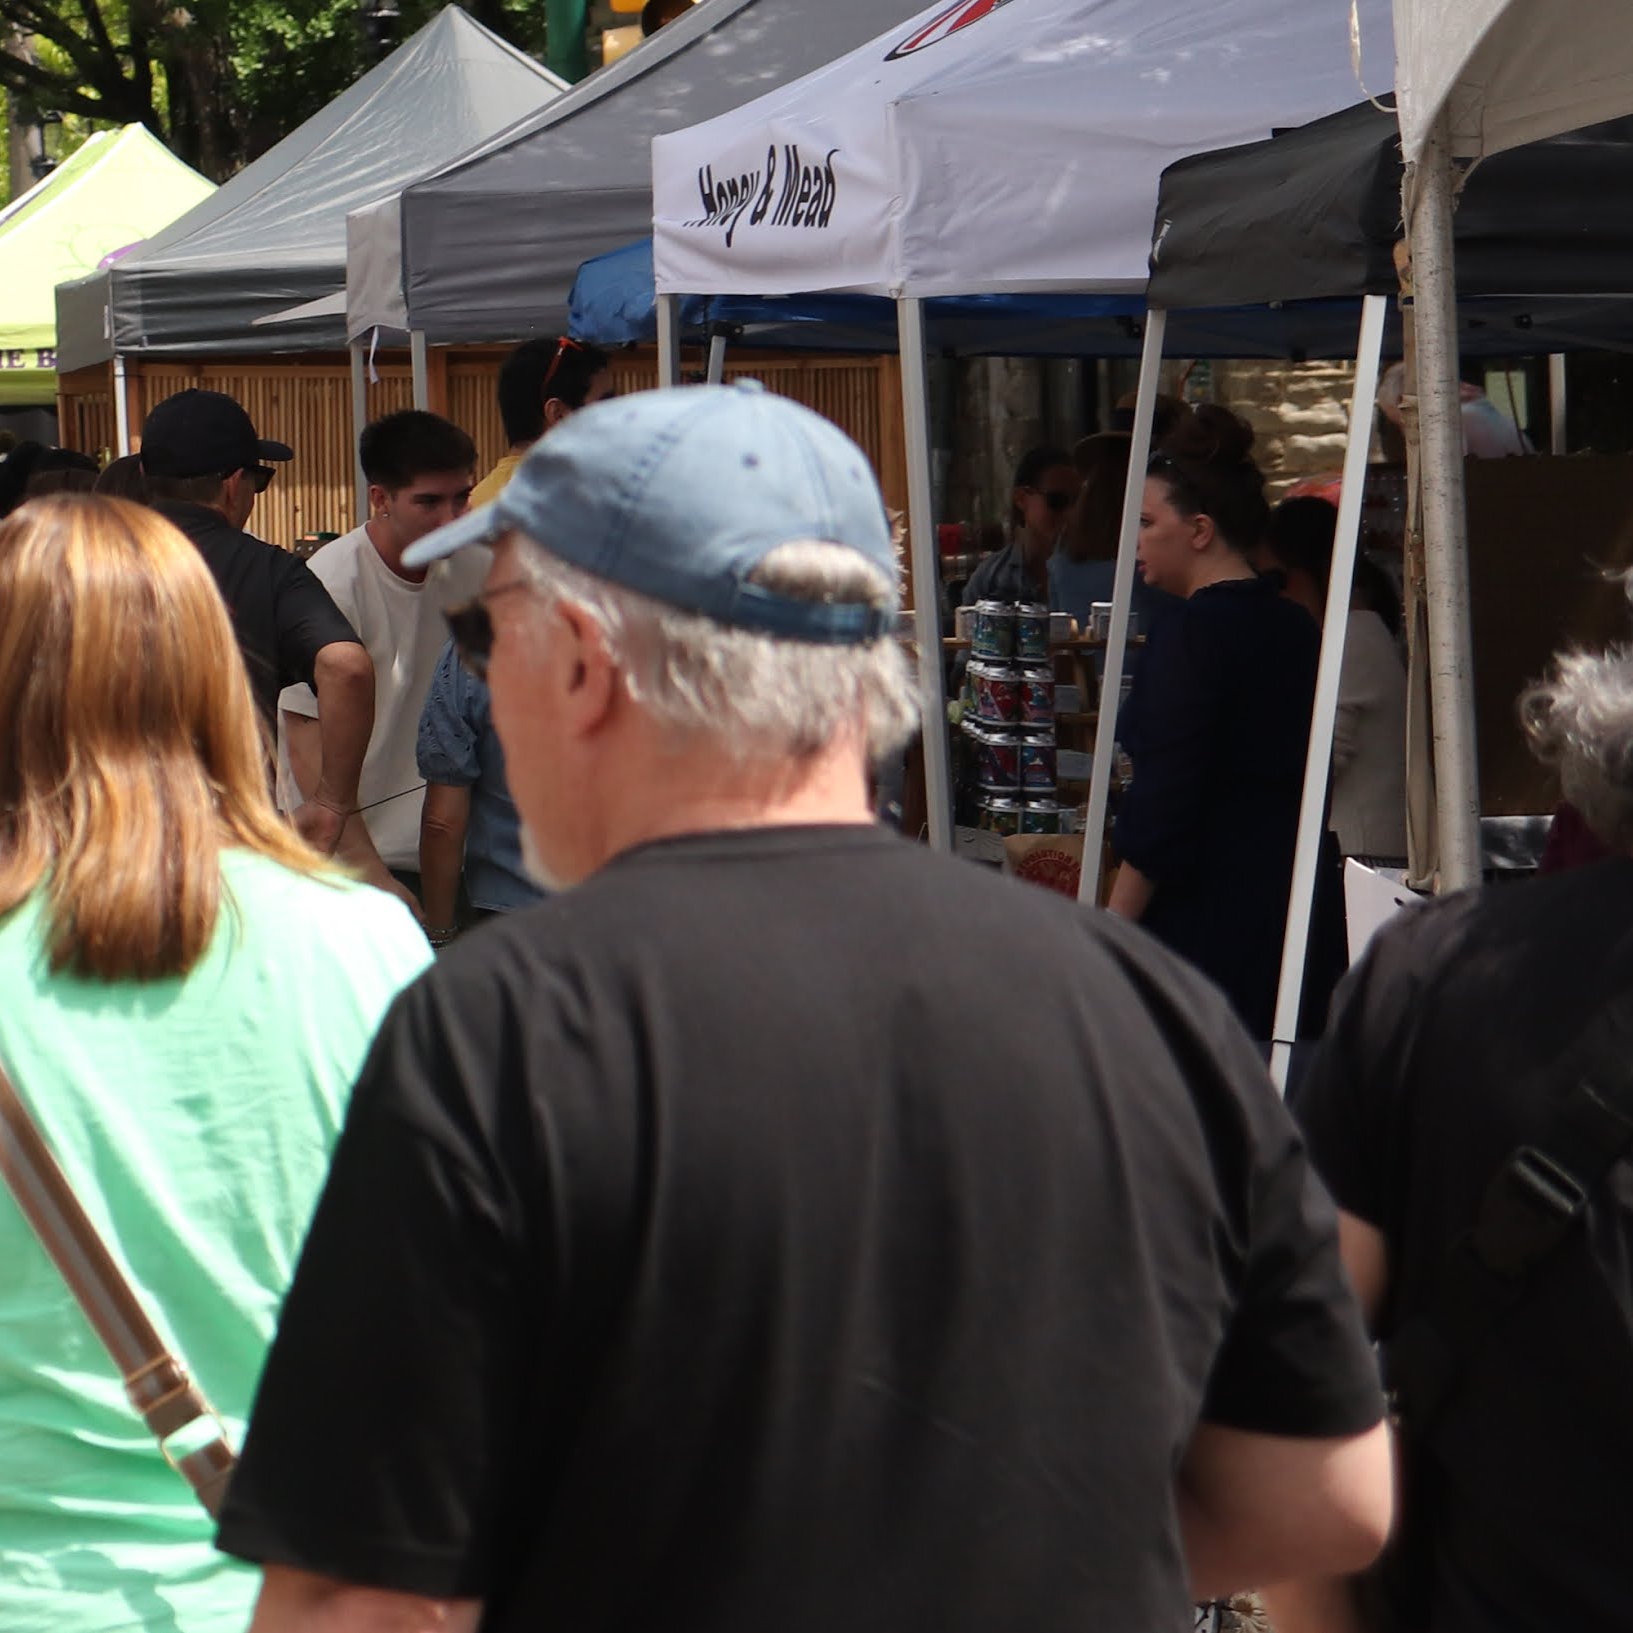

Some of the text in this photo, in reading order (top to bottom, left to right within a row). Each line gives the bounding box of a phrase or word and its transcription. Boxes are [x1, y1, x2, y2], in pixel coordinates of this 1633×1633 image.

[683, 144, 840, 249] Honey & Mead
